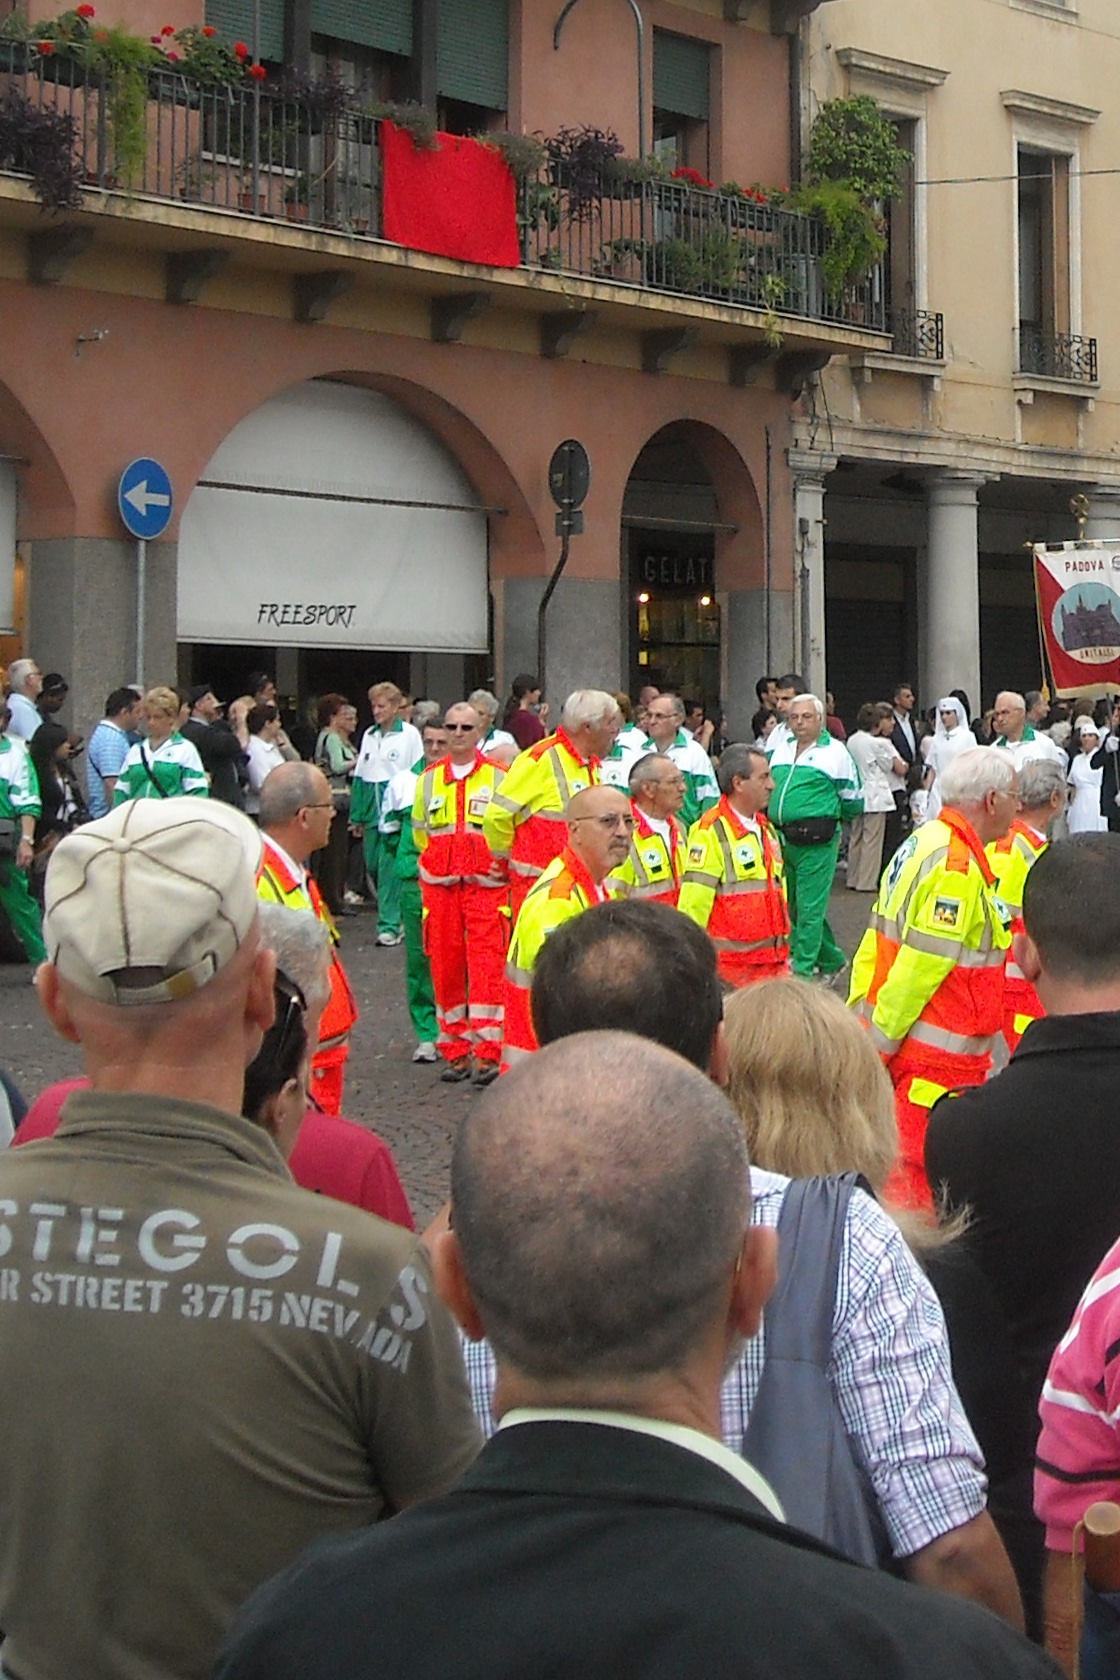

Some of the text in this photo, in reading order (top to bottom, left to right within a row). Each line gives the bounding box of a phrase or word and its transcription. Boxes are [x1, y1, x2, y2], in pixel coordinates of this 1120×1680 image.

[1065, 560, 1104, 573] PADOVA
[257, 603, 357, 628] FREESPORT
[30, 1271, 168, 1313] STREET
[181, 1283, 273, 1322] 3715
[279, 1292, 413, 1374] NEVADA
